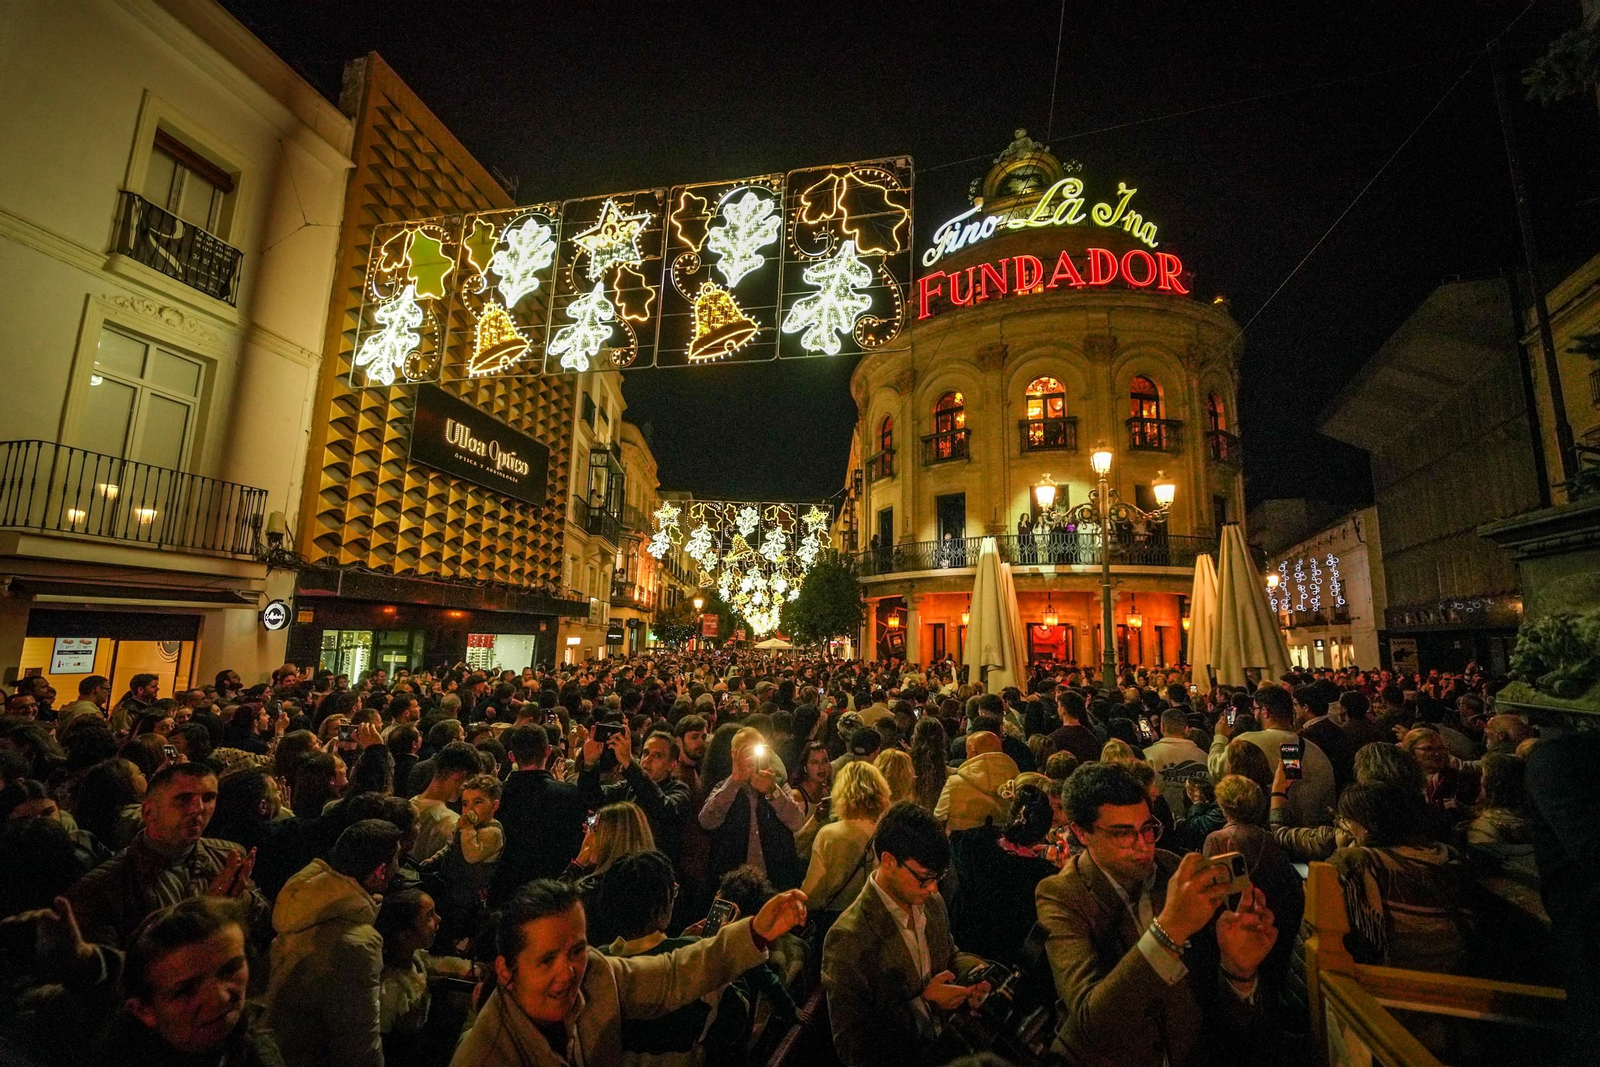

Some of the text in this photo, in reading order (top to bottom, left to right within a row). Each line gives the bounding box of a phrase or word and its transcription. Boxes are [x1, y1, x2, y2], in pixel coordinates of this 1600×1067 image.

[922, 177, 1159, 267] Fino La Ina
[918, 247, 1190, 320] FUNDADOR
[445, 418, 487, 456] Ulloa
[1164, 768, 1209, 780] GLOBAL
